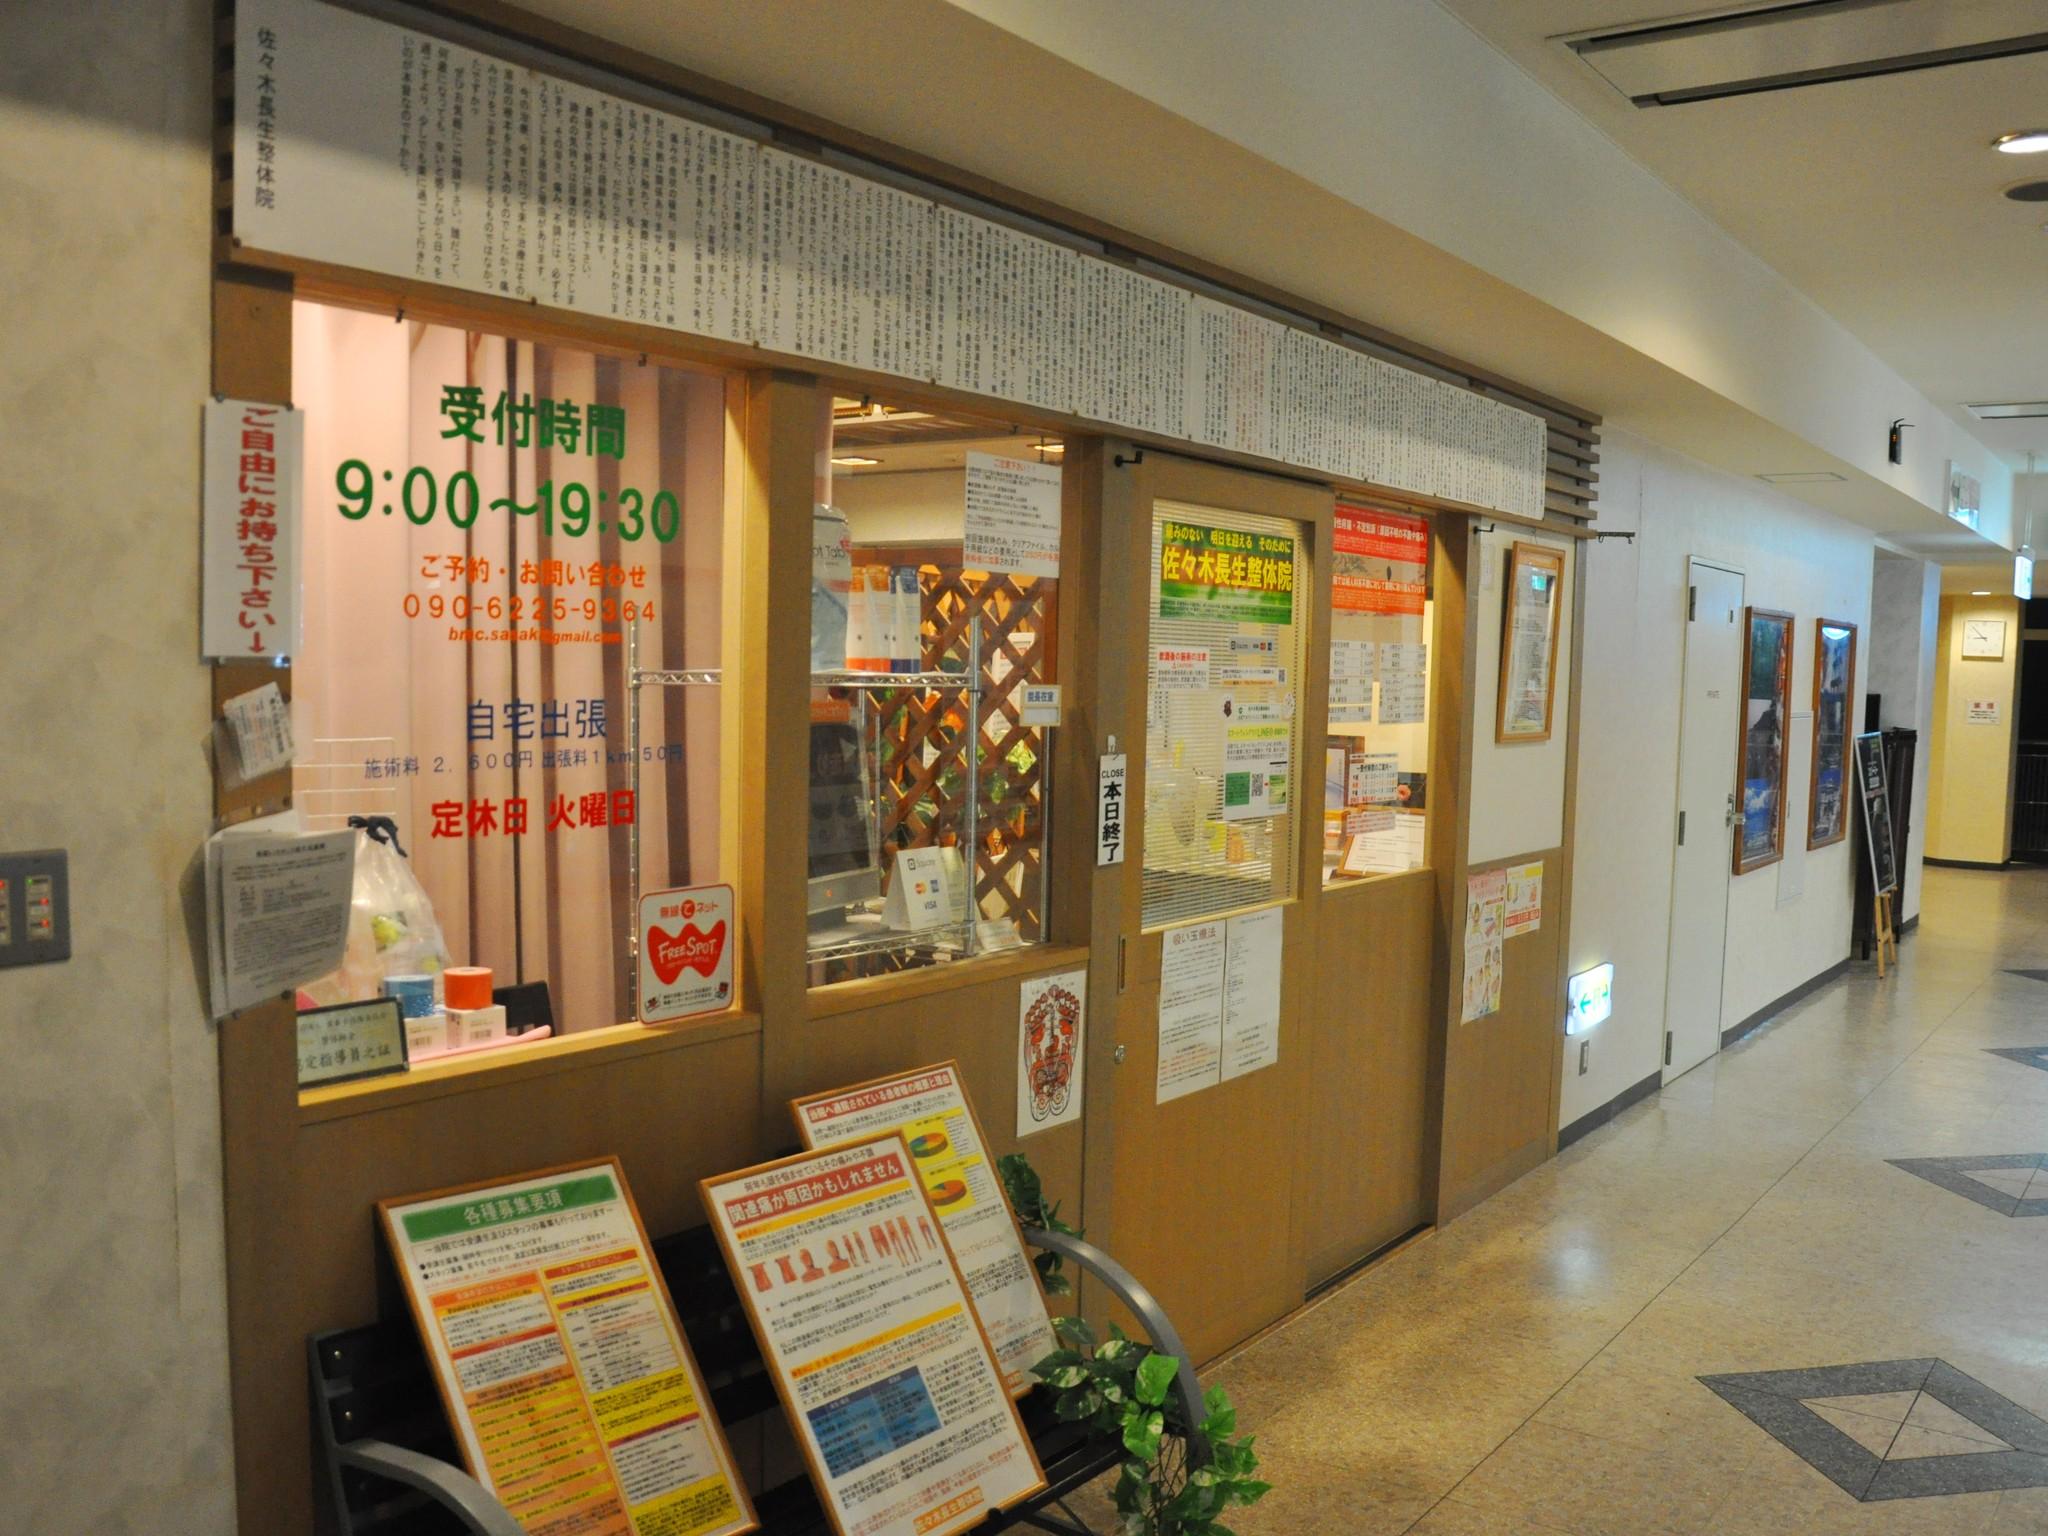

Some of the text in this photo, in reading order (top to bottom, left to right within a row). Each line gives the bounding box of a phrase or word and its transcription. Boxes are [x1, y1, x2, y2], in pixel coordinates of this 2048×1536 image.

[254, 27, 277, 210] 佐々木長生整体院
[440, 384, 627, 461] 受付時間
[237, 407, 278, 629] ご自由にお待ち下さい
[1210, 530, 1253, 549] 明日を迎える
[1259, 537, 1292, 553] そのために
[421, 554, 646, 588] ご予約・お問い合わせ
[1162, 546, 1293, 592] 佐々木長生整体院
[403, 593, 656, 622] 090-6225-9364
[467, 699, 607, 742] 自宅出張
[365, 756, 420, 780] 施術料
[1102, 768, 1124, 778] CLOSE
[431, 789, 636, 839] 定休日 火曜日
[1103, 781, 1122, 862] 本日終了
[463, 1188, 565, 1227] 各種募集要項
[727, 1159, 900, 1223] 関連痛が原因かもしれません
